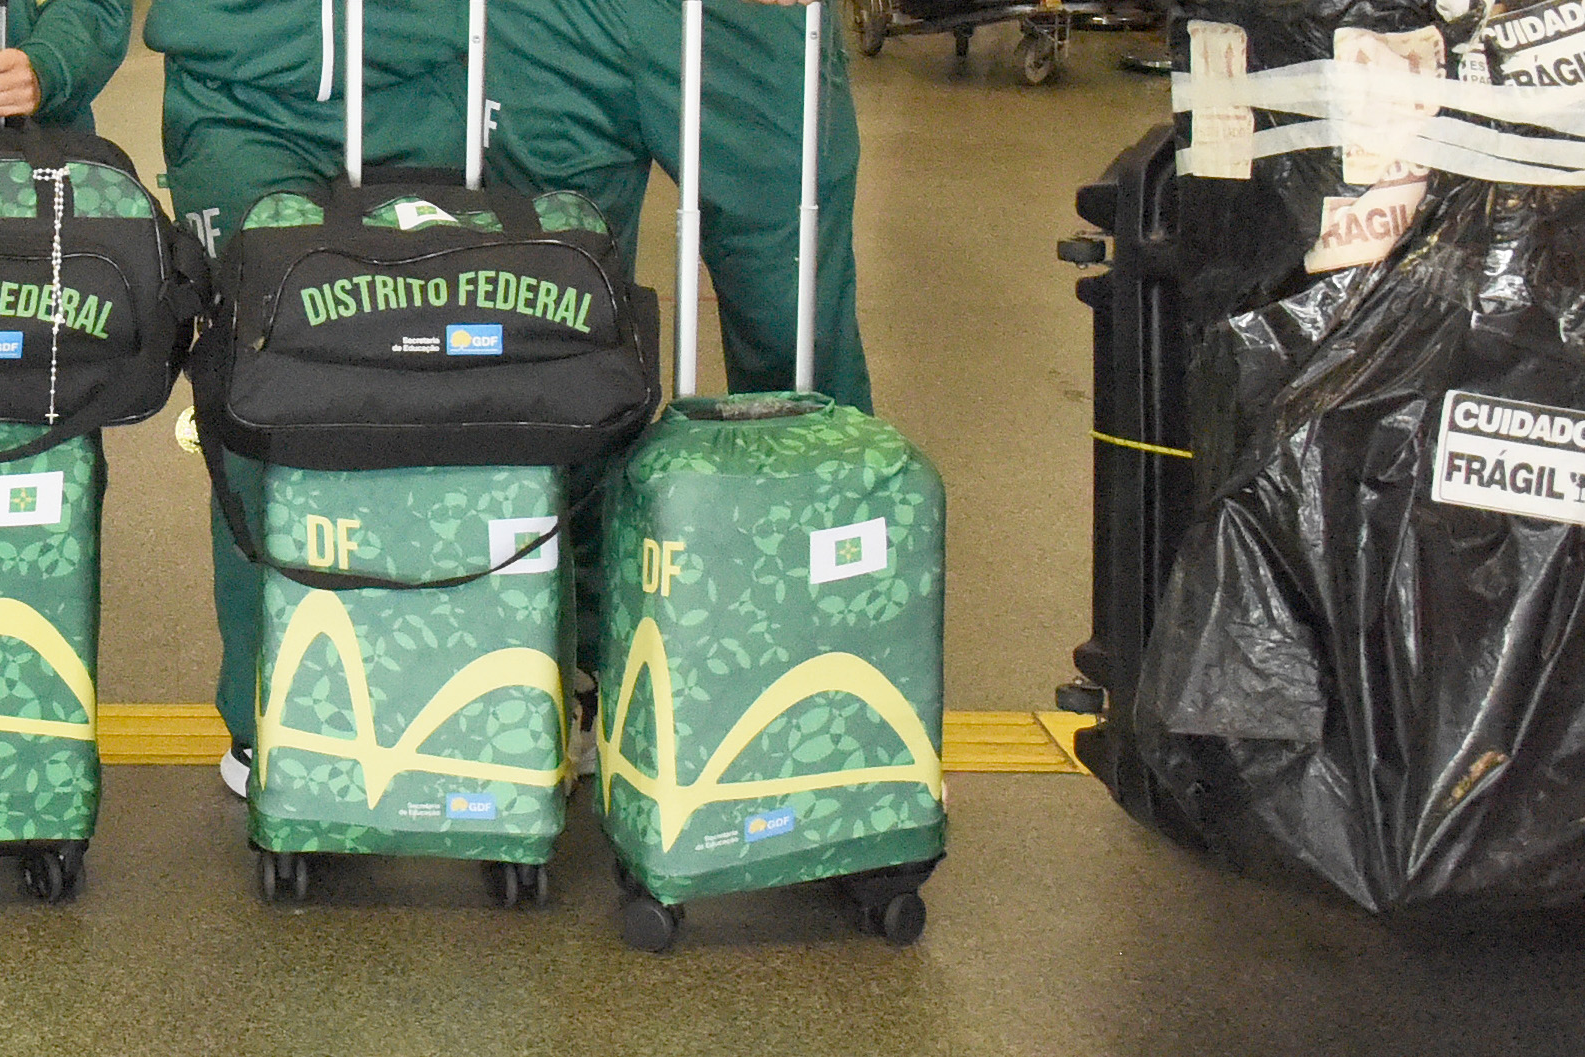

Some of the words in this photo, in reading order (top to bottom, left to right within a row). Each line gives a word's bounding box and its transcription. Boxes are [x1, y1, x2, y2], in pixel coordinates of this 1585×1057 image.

[300, 275, 448, 327] DISTRITO
[459, 270, 592, 334] FEDERAL
[472, 336, 499, 347] GDF
[1444, 449, 1565, 500] FRÁGIL
[306, 514, 362, 570] DF
[642, 538, 686, 597] DF
[468, 802, 492, 812] GDF
[766, 815, 790, 830] GDF
